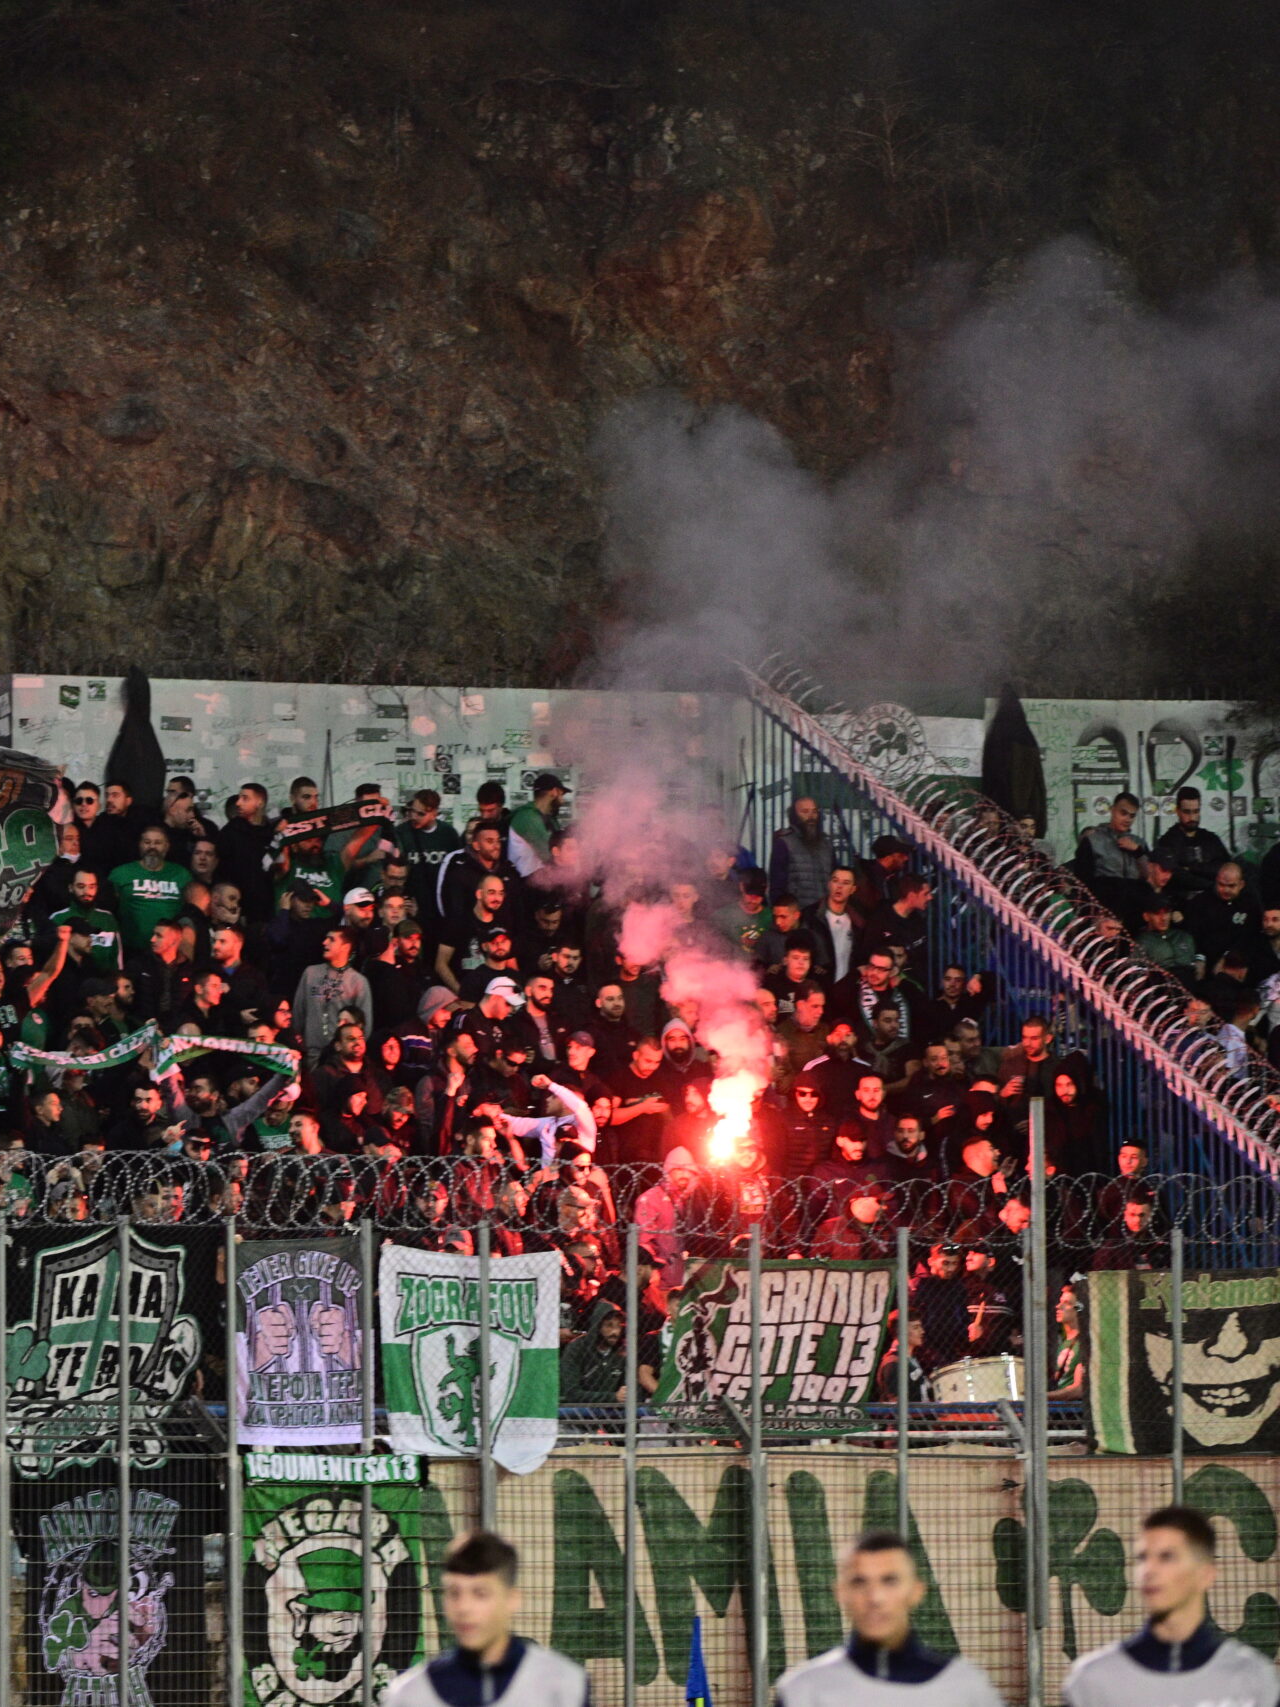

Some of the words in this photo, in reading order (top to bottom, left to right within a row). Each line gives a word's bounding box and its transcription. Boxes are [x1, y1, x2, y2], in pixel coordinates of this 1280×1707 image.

[133, 879, 179, 895] LAMIA
[729, 1269, 889, 1325] AGRINIO
[1140, 1272, 1280, 1323] Kalama
[715, 1324, 824, 1375] GATE
[834, 1324, 881, 1376] 13
[788, 1373, 869, 1414] 1997
[391, 1455, 417, 1481] 13
